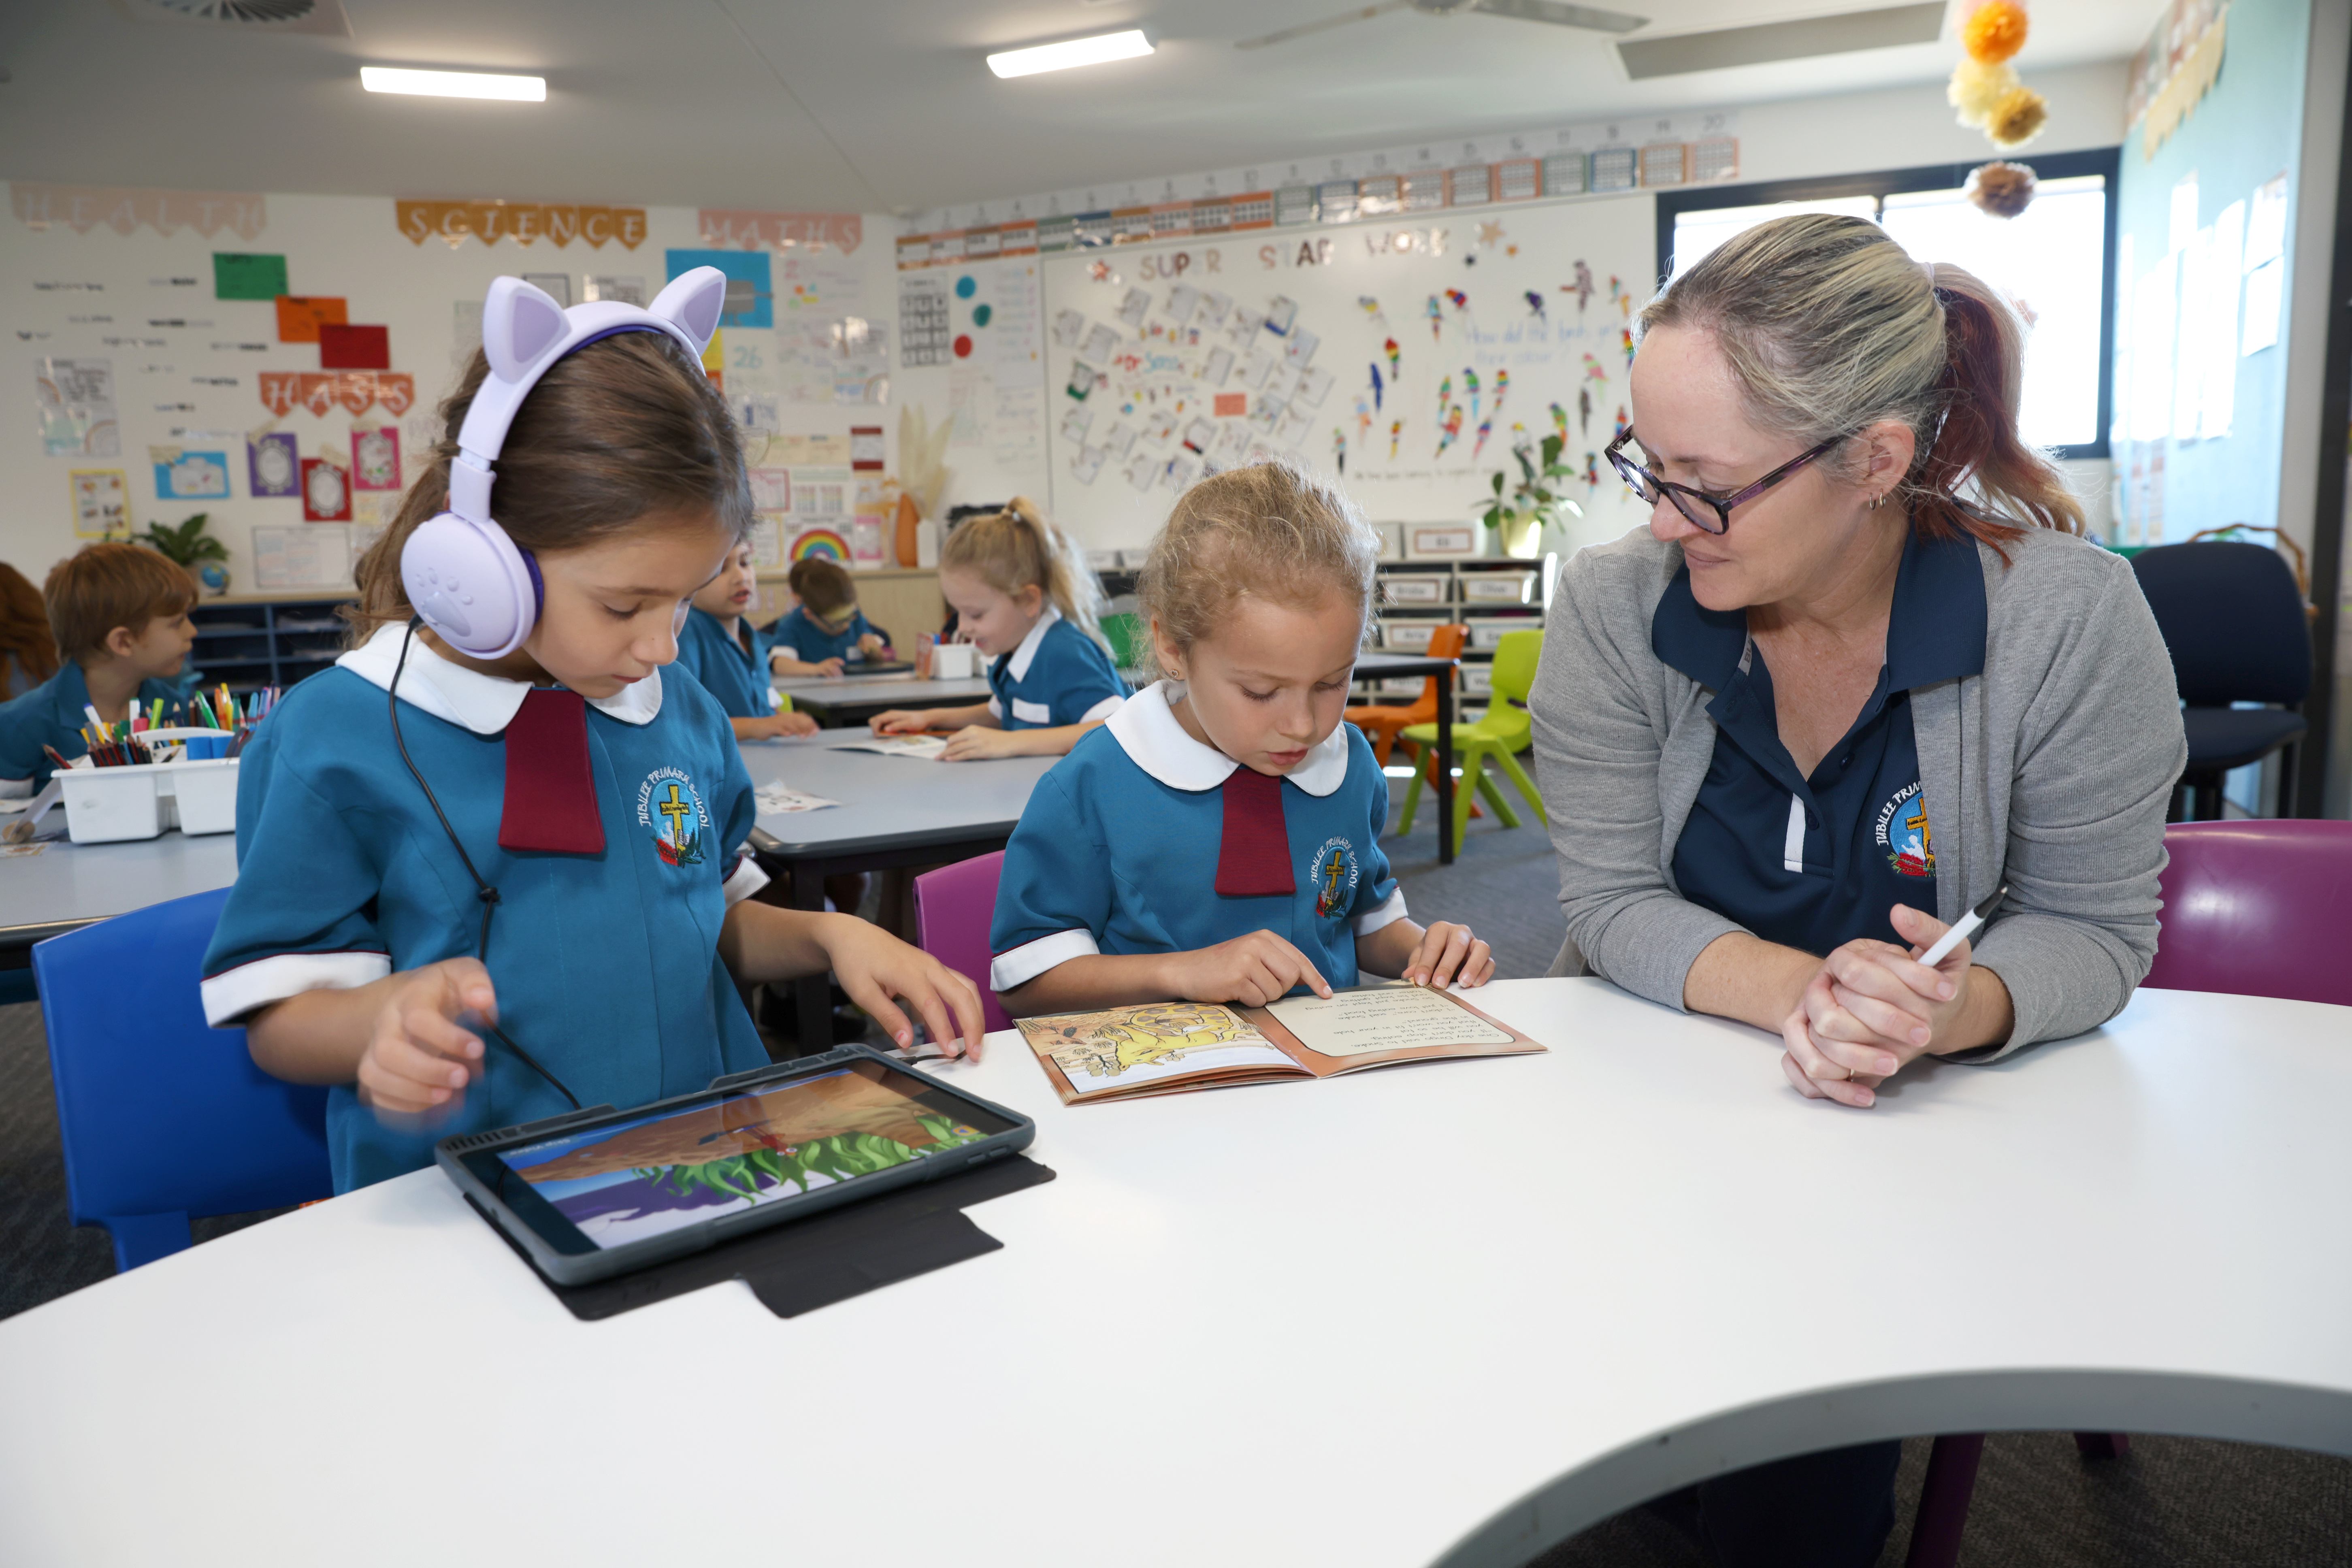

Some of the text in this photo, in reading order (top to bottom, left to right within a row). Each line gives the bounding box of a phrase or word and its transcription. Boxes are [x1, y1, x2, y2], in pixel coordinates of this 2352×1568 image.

[24, 192, 262, 232] HEALTH
[409, 207, 643, 242] SCIENCE
[704, 216, 856, 244] MATHS
[270, 380, 406, 411] HASS
[637, 766, 709, 830] JUBILEE PRIMARY SCHOOL
[1875, 801, 1896, 846] JUBILEE
[1310, 836, 1358, 888] JUBILEE PRIMARY SCHOOL
